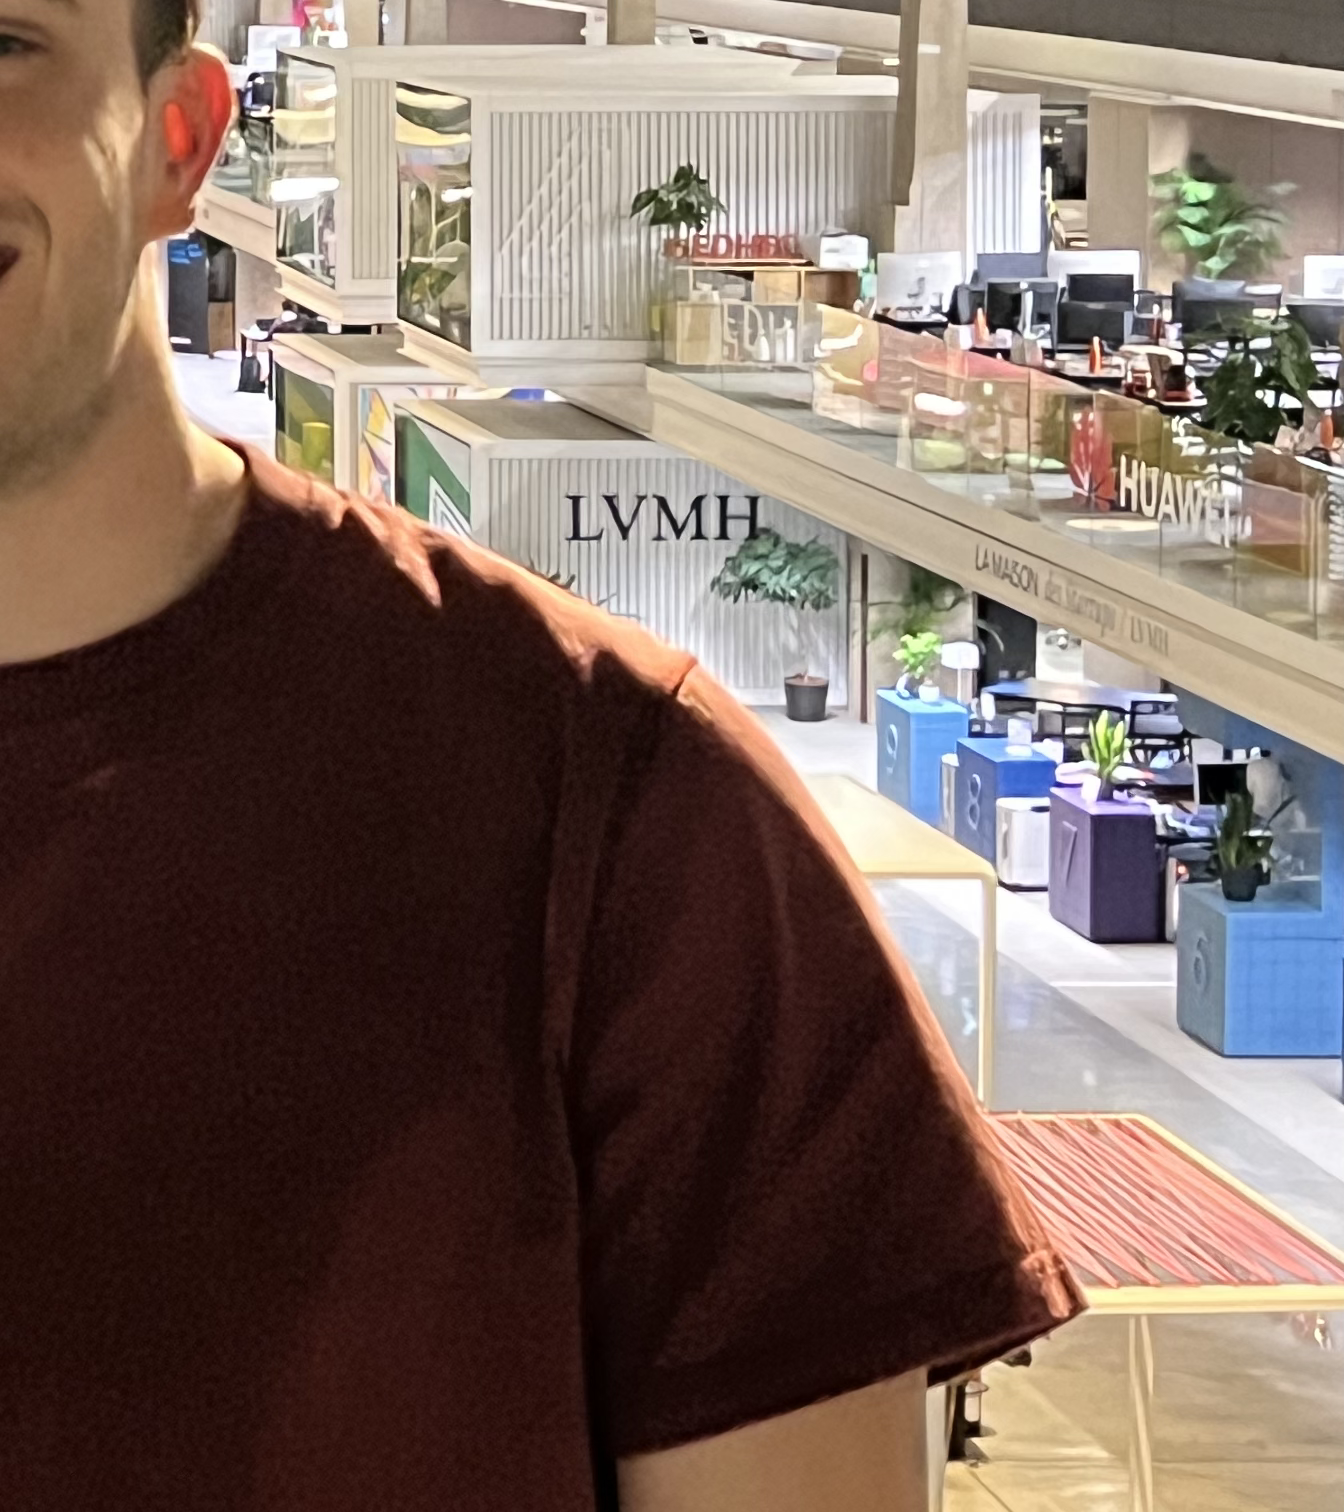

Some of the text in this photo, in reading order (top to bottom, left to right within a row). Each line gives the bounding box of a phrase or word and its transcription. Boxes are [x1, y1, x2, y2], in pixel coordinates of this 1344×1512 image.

[565, 493, 760, 541] LVMH
[1120, 453, 1231, 548] HUAWEI
[886, 723, 899, 775] 9
[968, 773, 982, 830] 8
[1061, 820, 1078, 886] 7
[1190, 931, 1208, 992] 6
